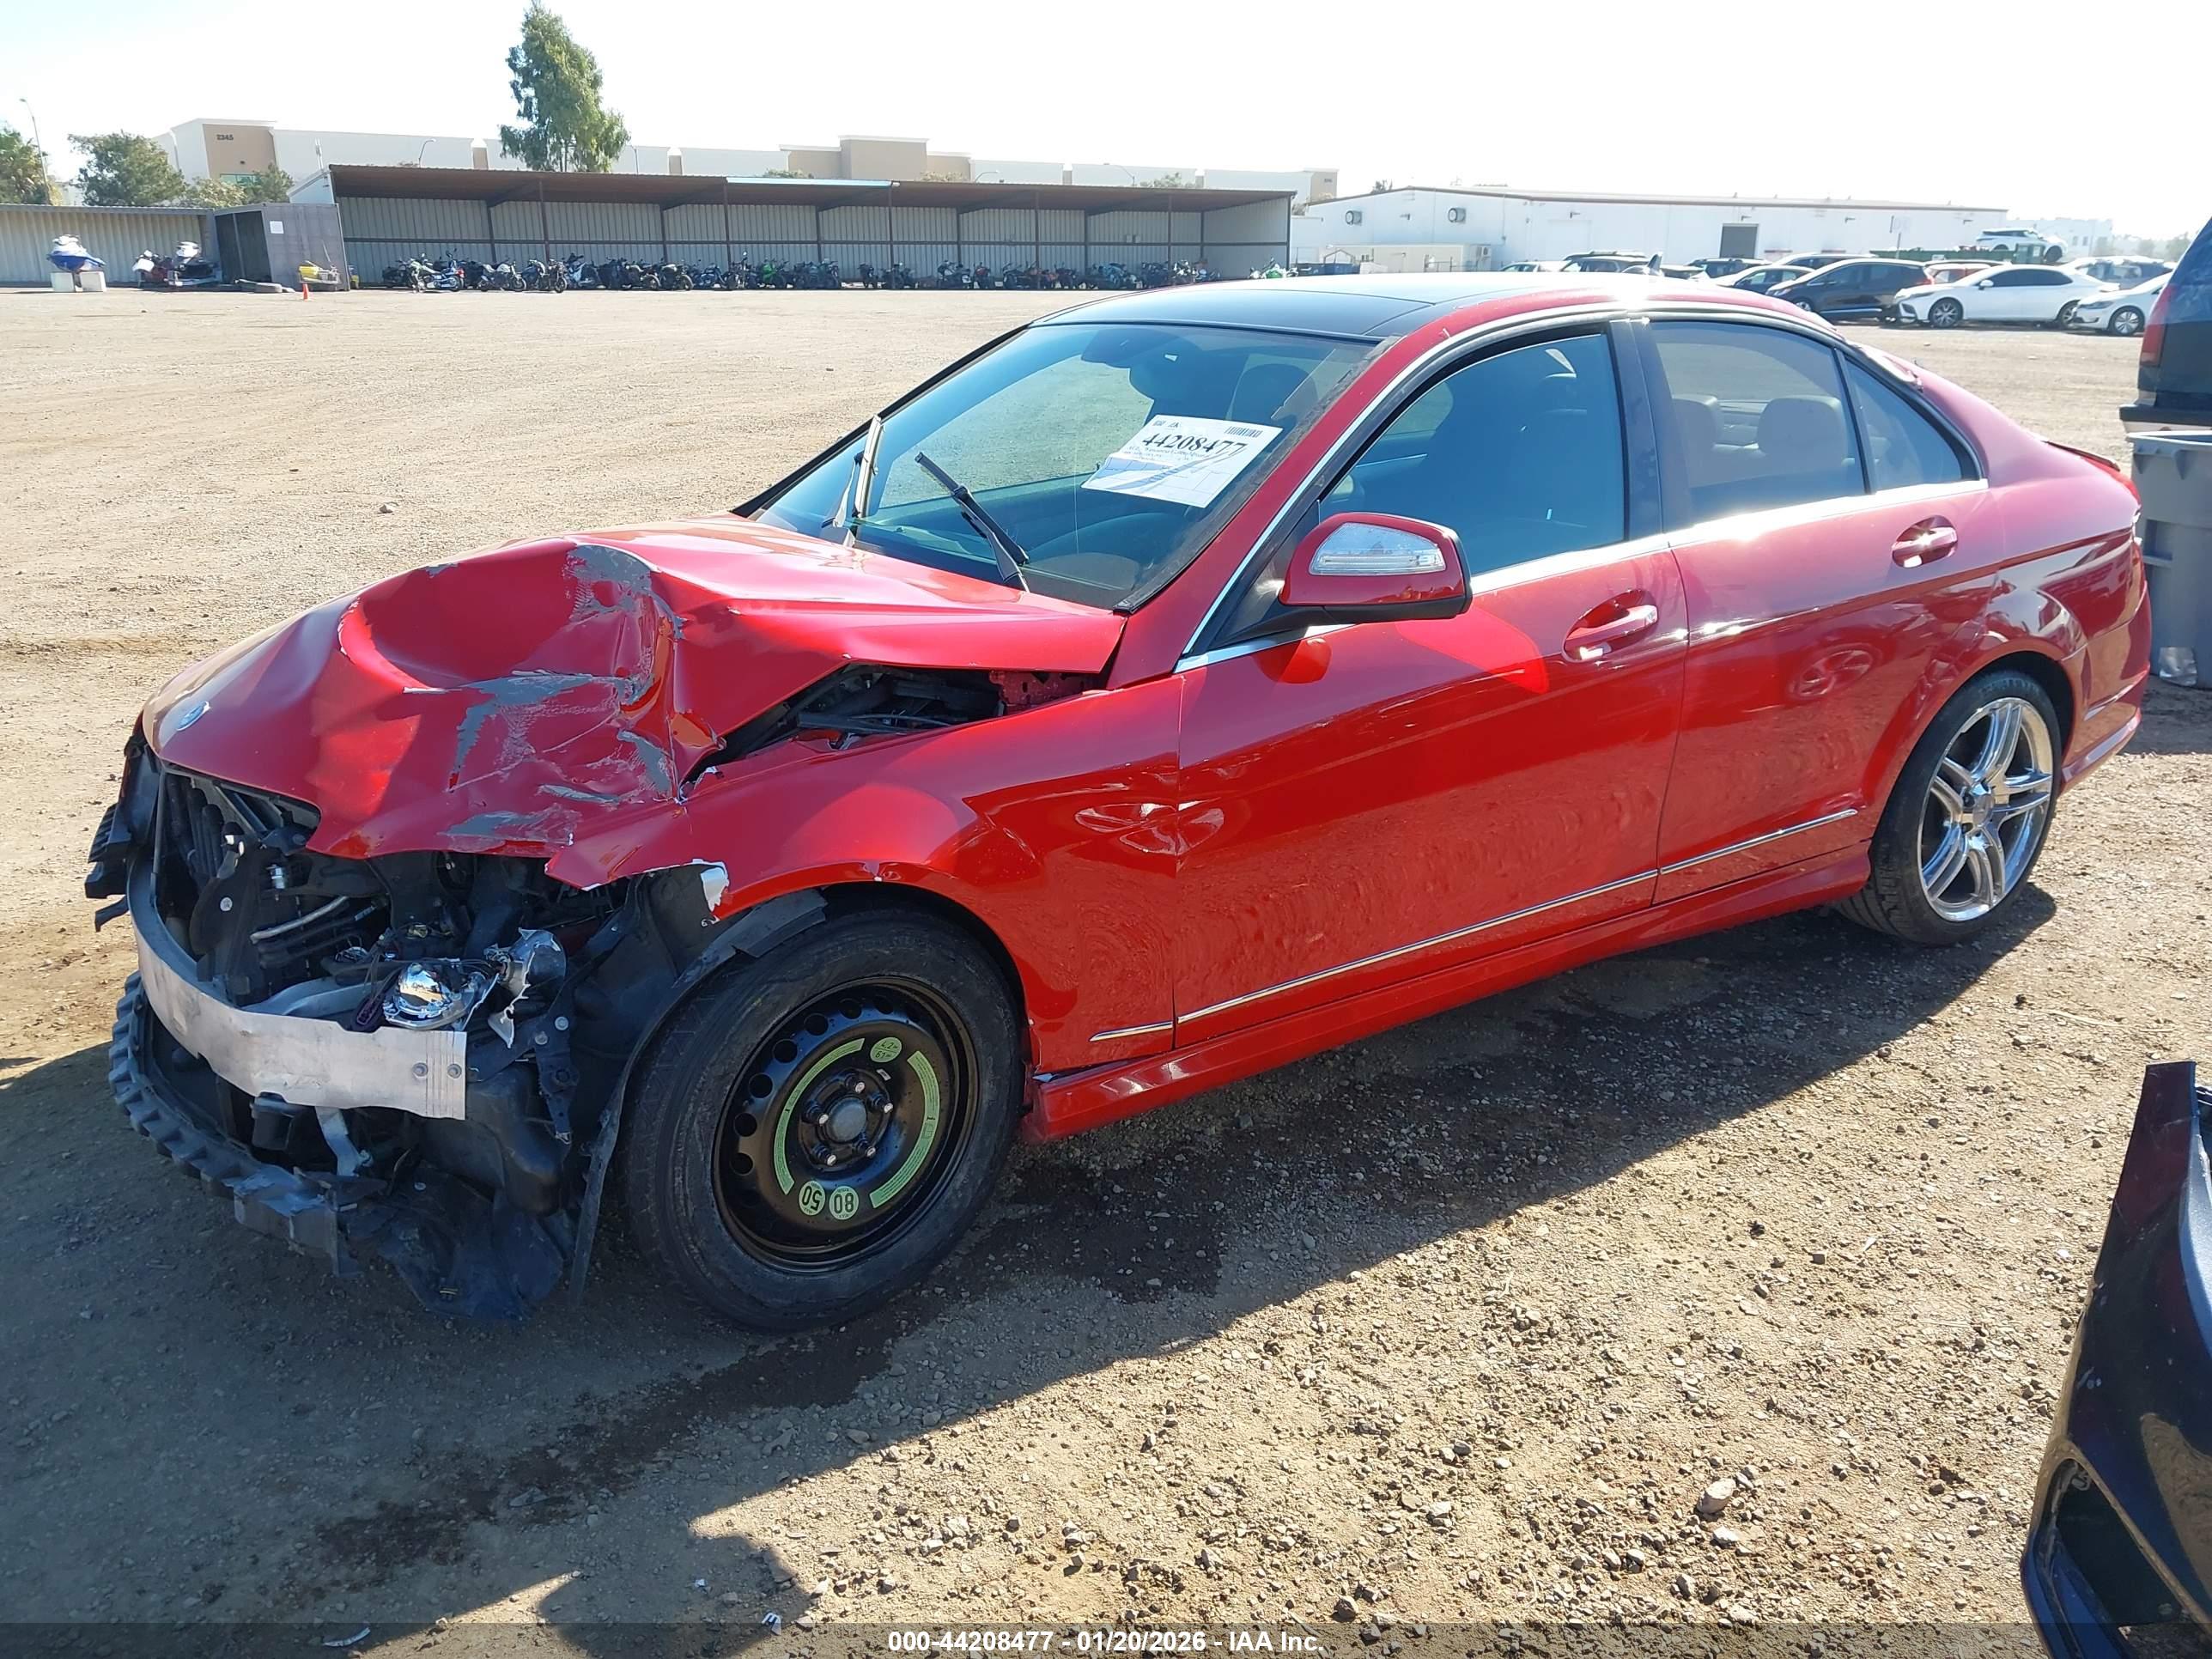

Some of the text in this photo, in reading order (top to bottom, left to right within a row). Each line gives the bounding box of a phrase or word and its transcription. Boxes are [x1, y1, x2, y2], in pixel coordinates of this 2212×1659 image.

[1142, 433, 1249, 457] 44208477
[802, 1185, 823, 1211] 50
[834, 1192, 854, 1214] 80
